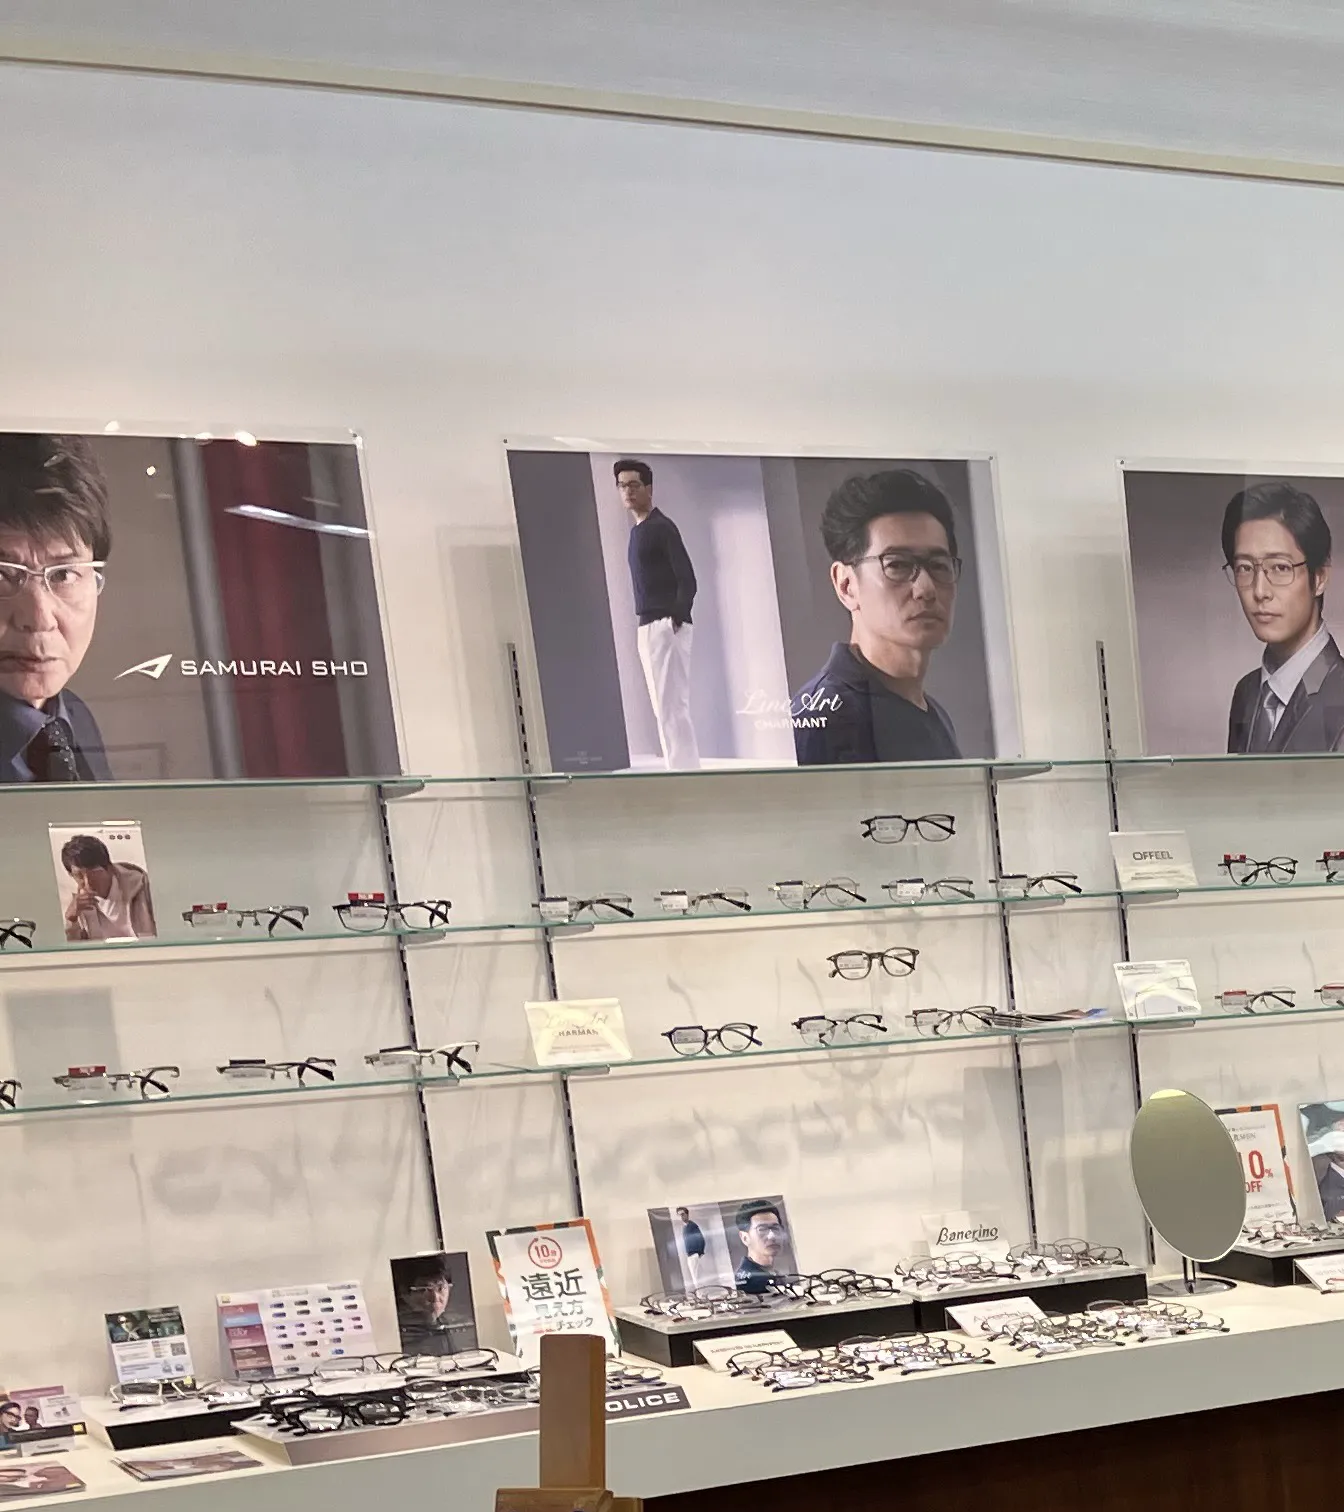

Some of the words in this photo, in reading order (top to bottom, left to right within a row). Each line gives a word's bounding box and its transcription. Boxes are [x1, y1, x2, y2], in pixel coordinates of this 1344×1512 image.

[180, 659, 302, 678] SAMURAI
[311, 660, 368, 678] SHO
[520, 1268, 587, 1302] 遠近
[604, 1392, 681, 1413] OLICE
